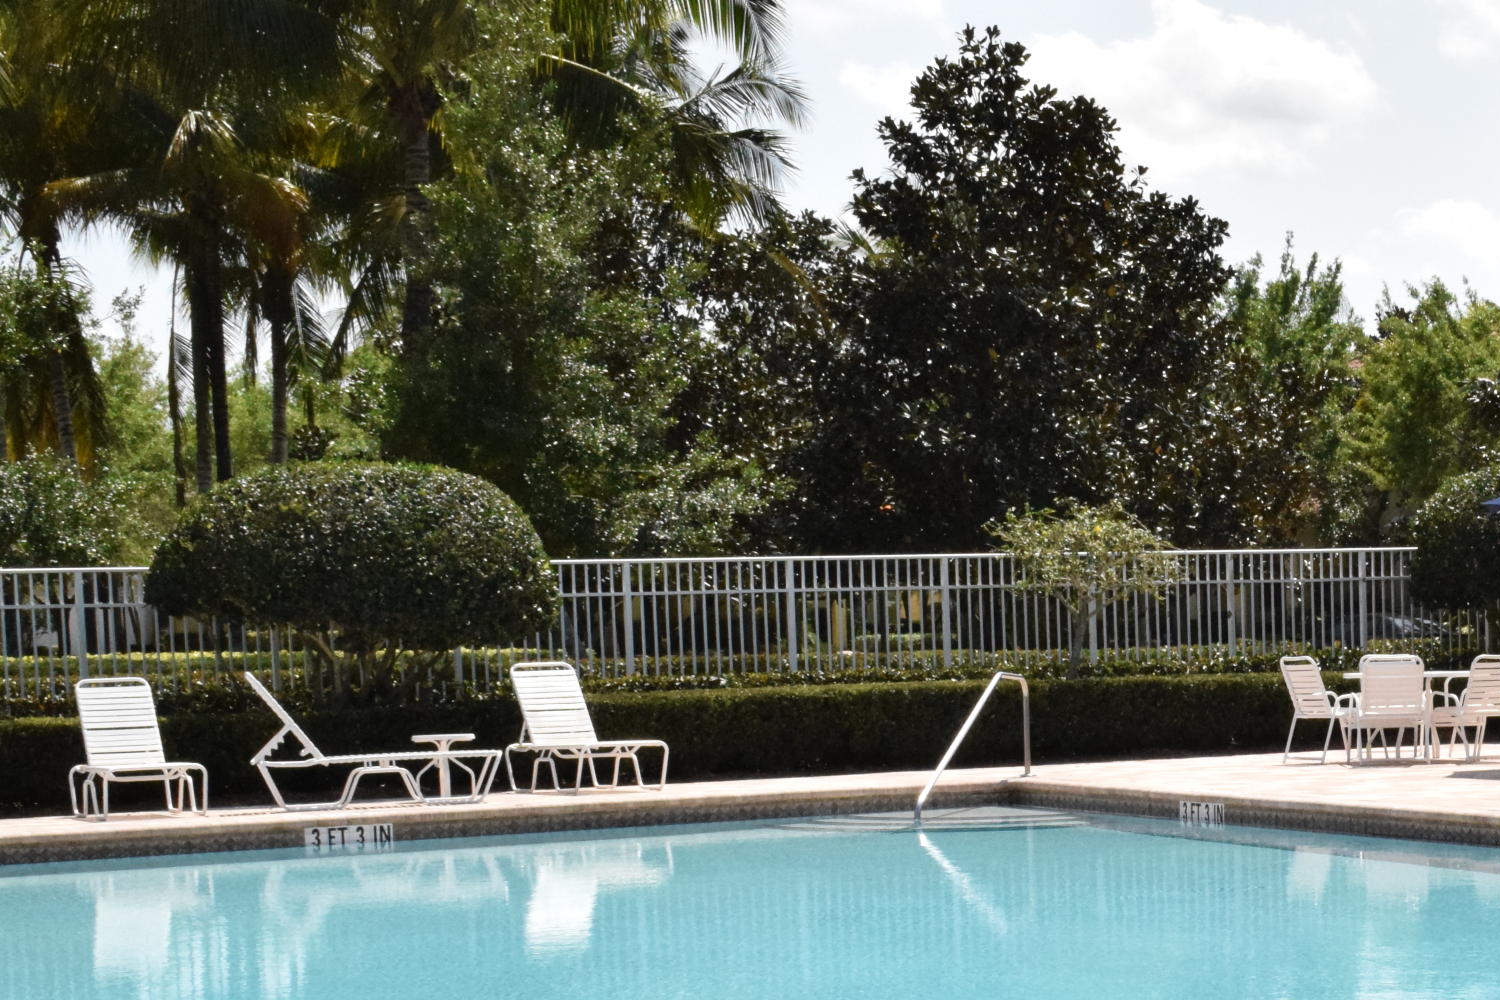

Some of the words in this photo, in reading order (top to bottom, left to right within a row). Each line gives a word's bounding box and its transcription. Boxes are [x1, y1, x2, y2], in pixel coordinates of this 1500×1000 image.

[1182, 802, 1188, 823] 3
[1191, 803, 1201, 824] FT
[1205, 804, 1210, 824] 3
[1213, 804, 1224, 825] IN
[311, 828, 321, 847] 3
[328, 827, 348, 845] FT
[356, 826, 365, 844] 3
[373, 825, 391, 843] IN
